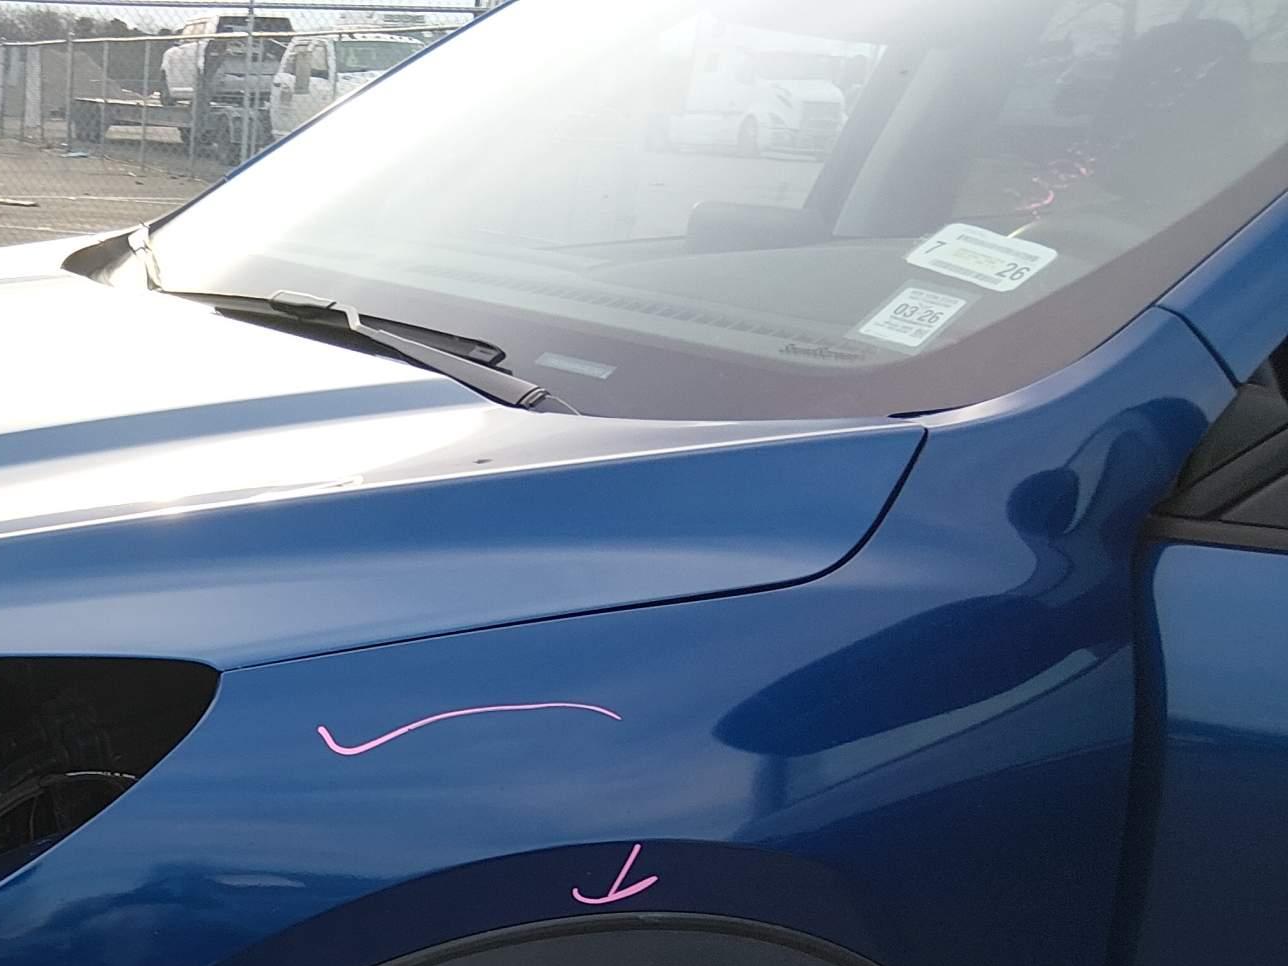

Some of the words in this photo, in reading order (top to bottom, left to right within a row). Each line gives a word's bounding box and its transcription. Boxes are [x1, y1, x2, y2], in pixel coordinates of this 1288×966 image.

[924, 240, 945, 254] 7
[995, 262, 1031, 281] 26
[893, 303, 920, 318] 03
[917, 309, 944, 324] 26
